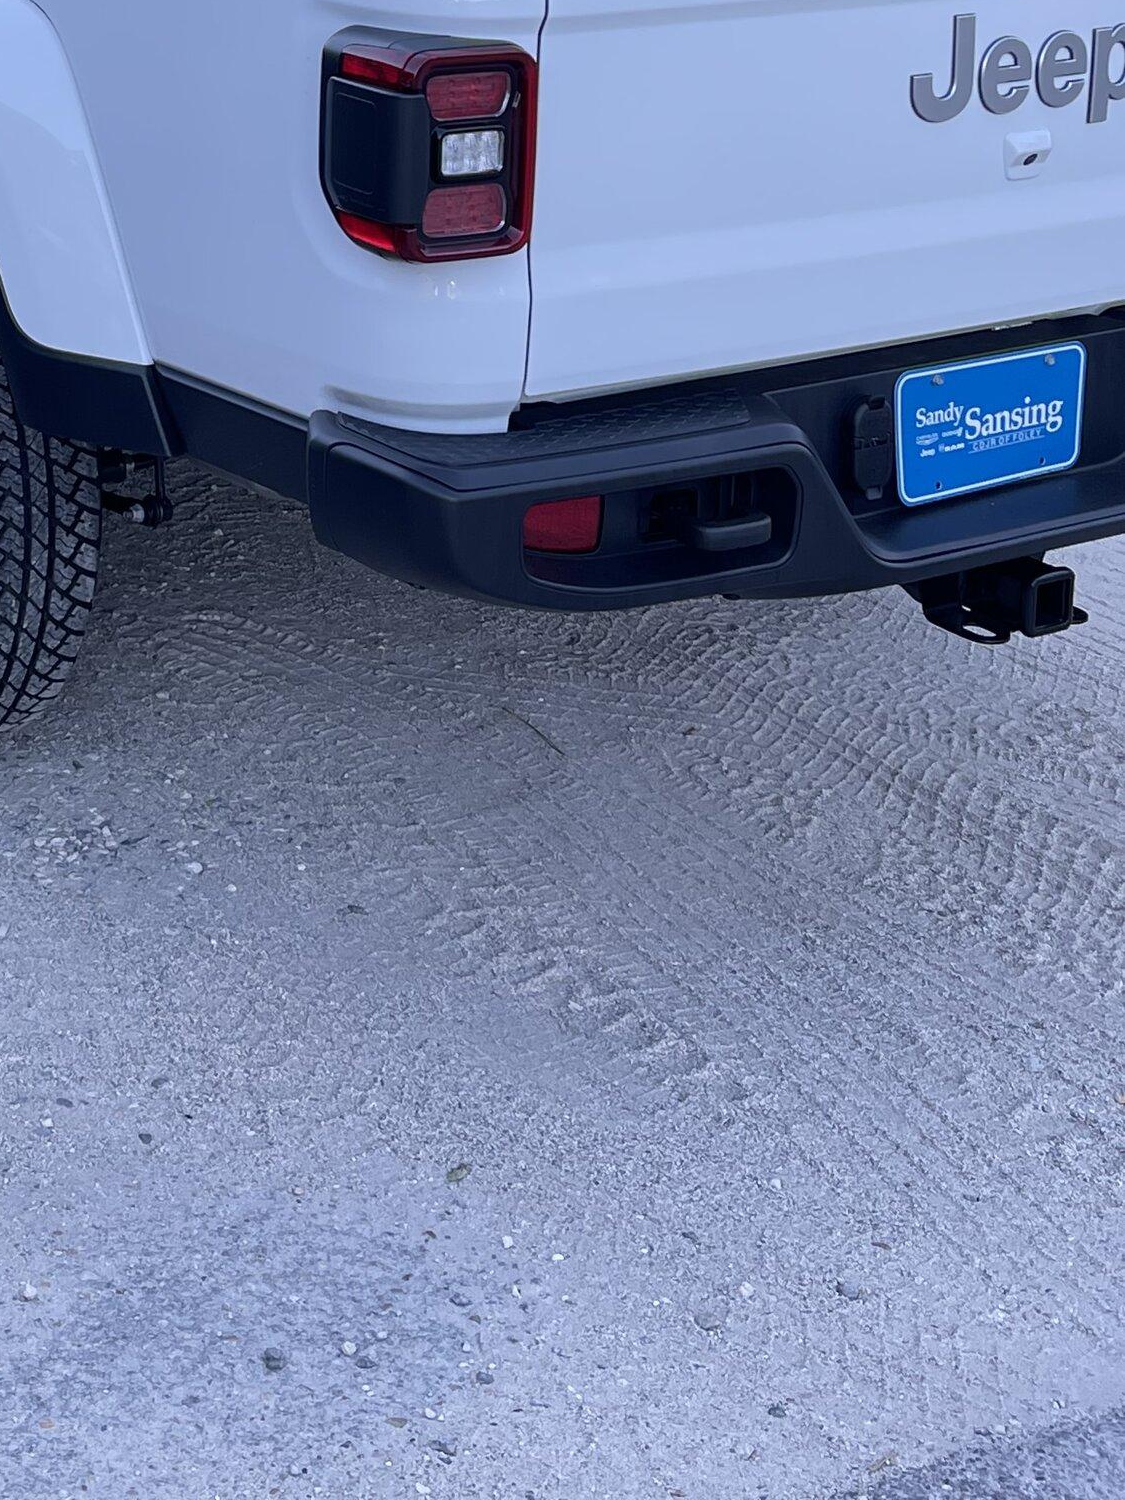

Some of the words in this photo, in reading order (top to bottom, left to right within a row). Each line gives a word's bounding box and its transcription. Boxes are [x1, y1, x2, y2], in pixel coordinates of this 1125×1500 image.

[909, 13, 1125, 124] Jeep
[915, 401, 965, 429] Sandy
[964, 396, 1065, 440] Sansing
[998, 434, 1011, 445] OF
[1012, 428, 1042, 442] FOLEY
